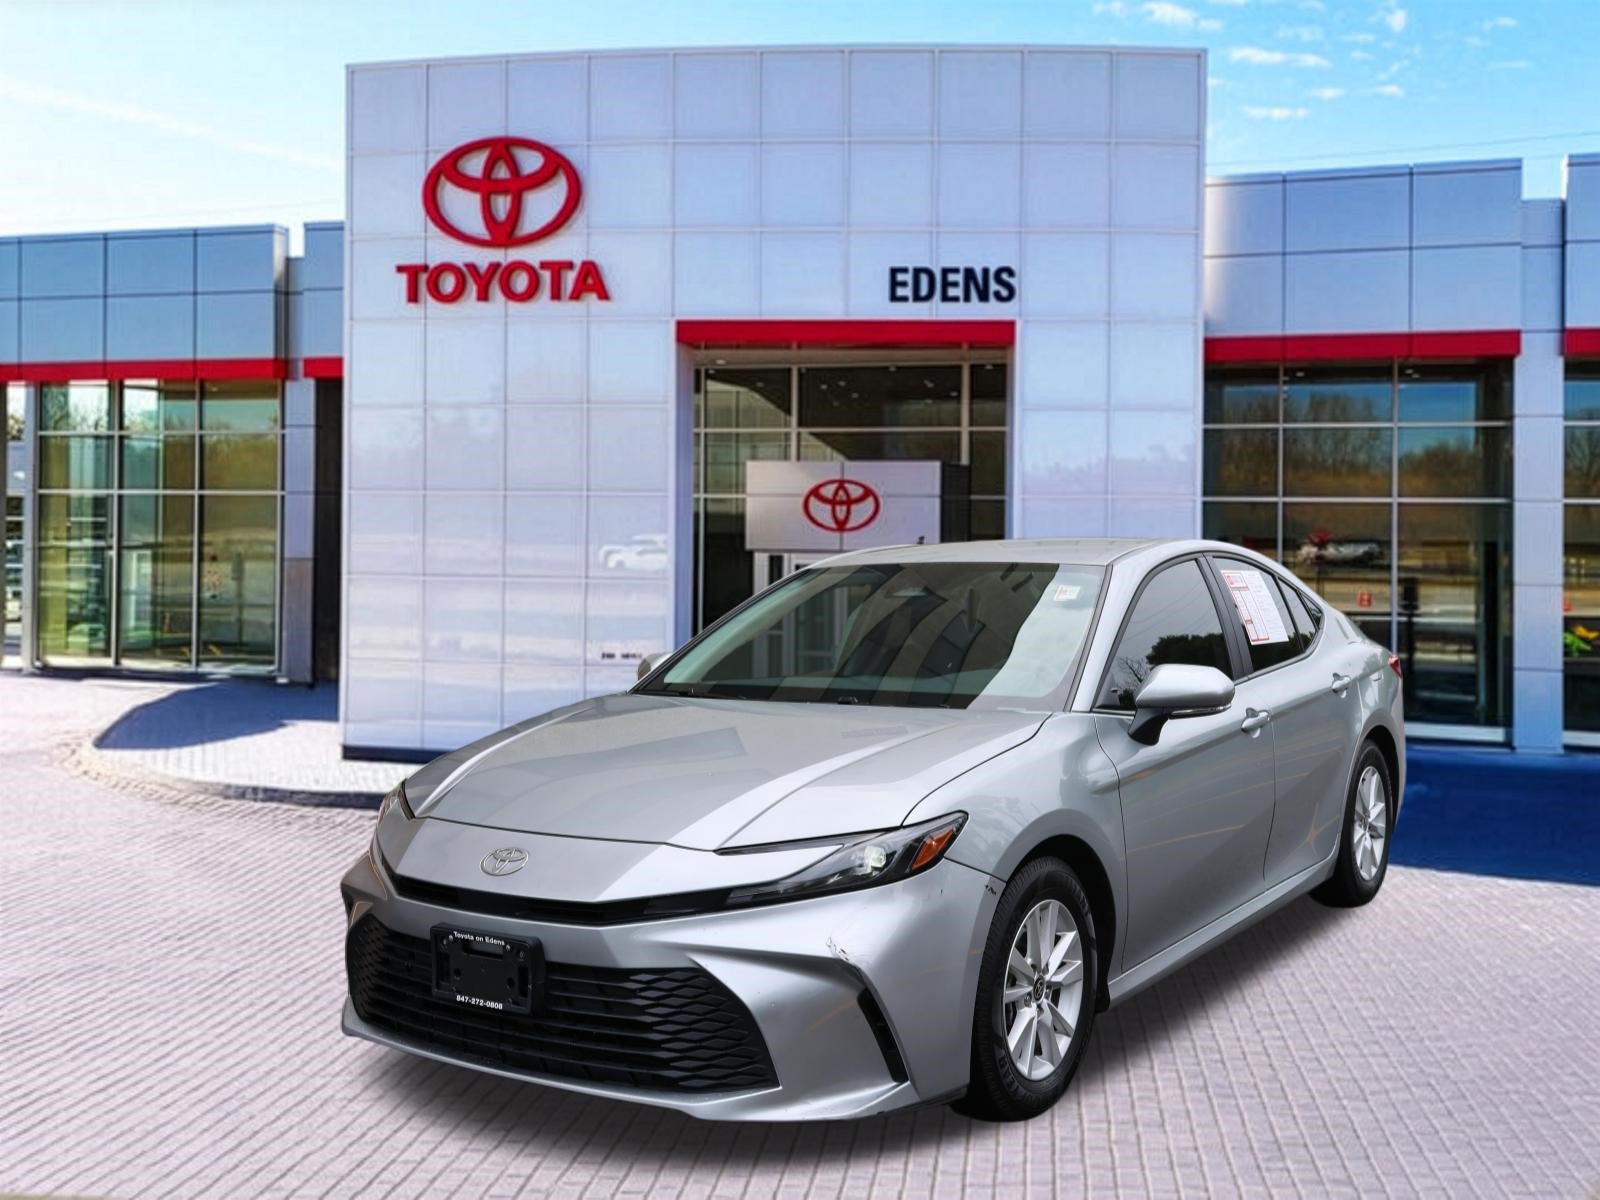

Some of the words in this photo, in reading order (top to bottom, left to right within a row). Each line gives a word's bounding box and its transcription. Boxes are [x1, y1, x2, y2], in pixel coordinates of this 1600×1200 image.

[396, 260, 610, 304] TOYOTA
[889, 266, 1016, 303] EDENS
[453, 931, 474, 941] Toyota
[485, 936, 505, 946] Edens
